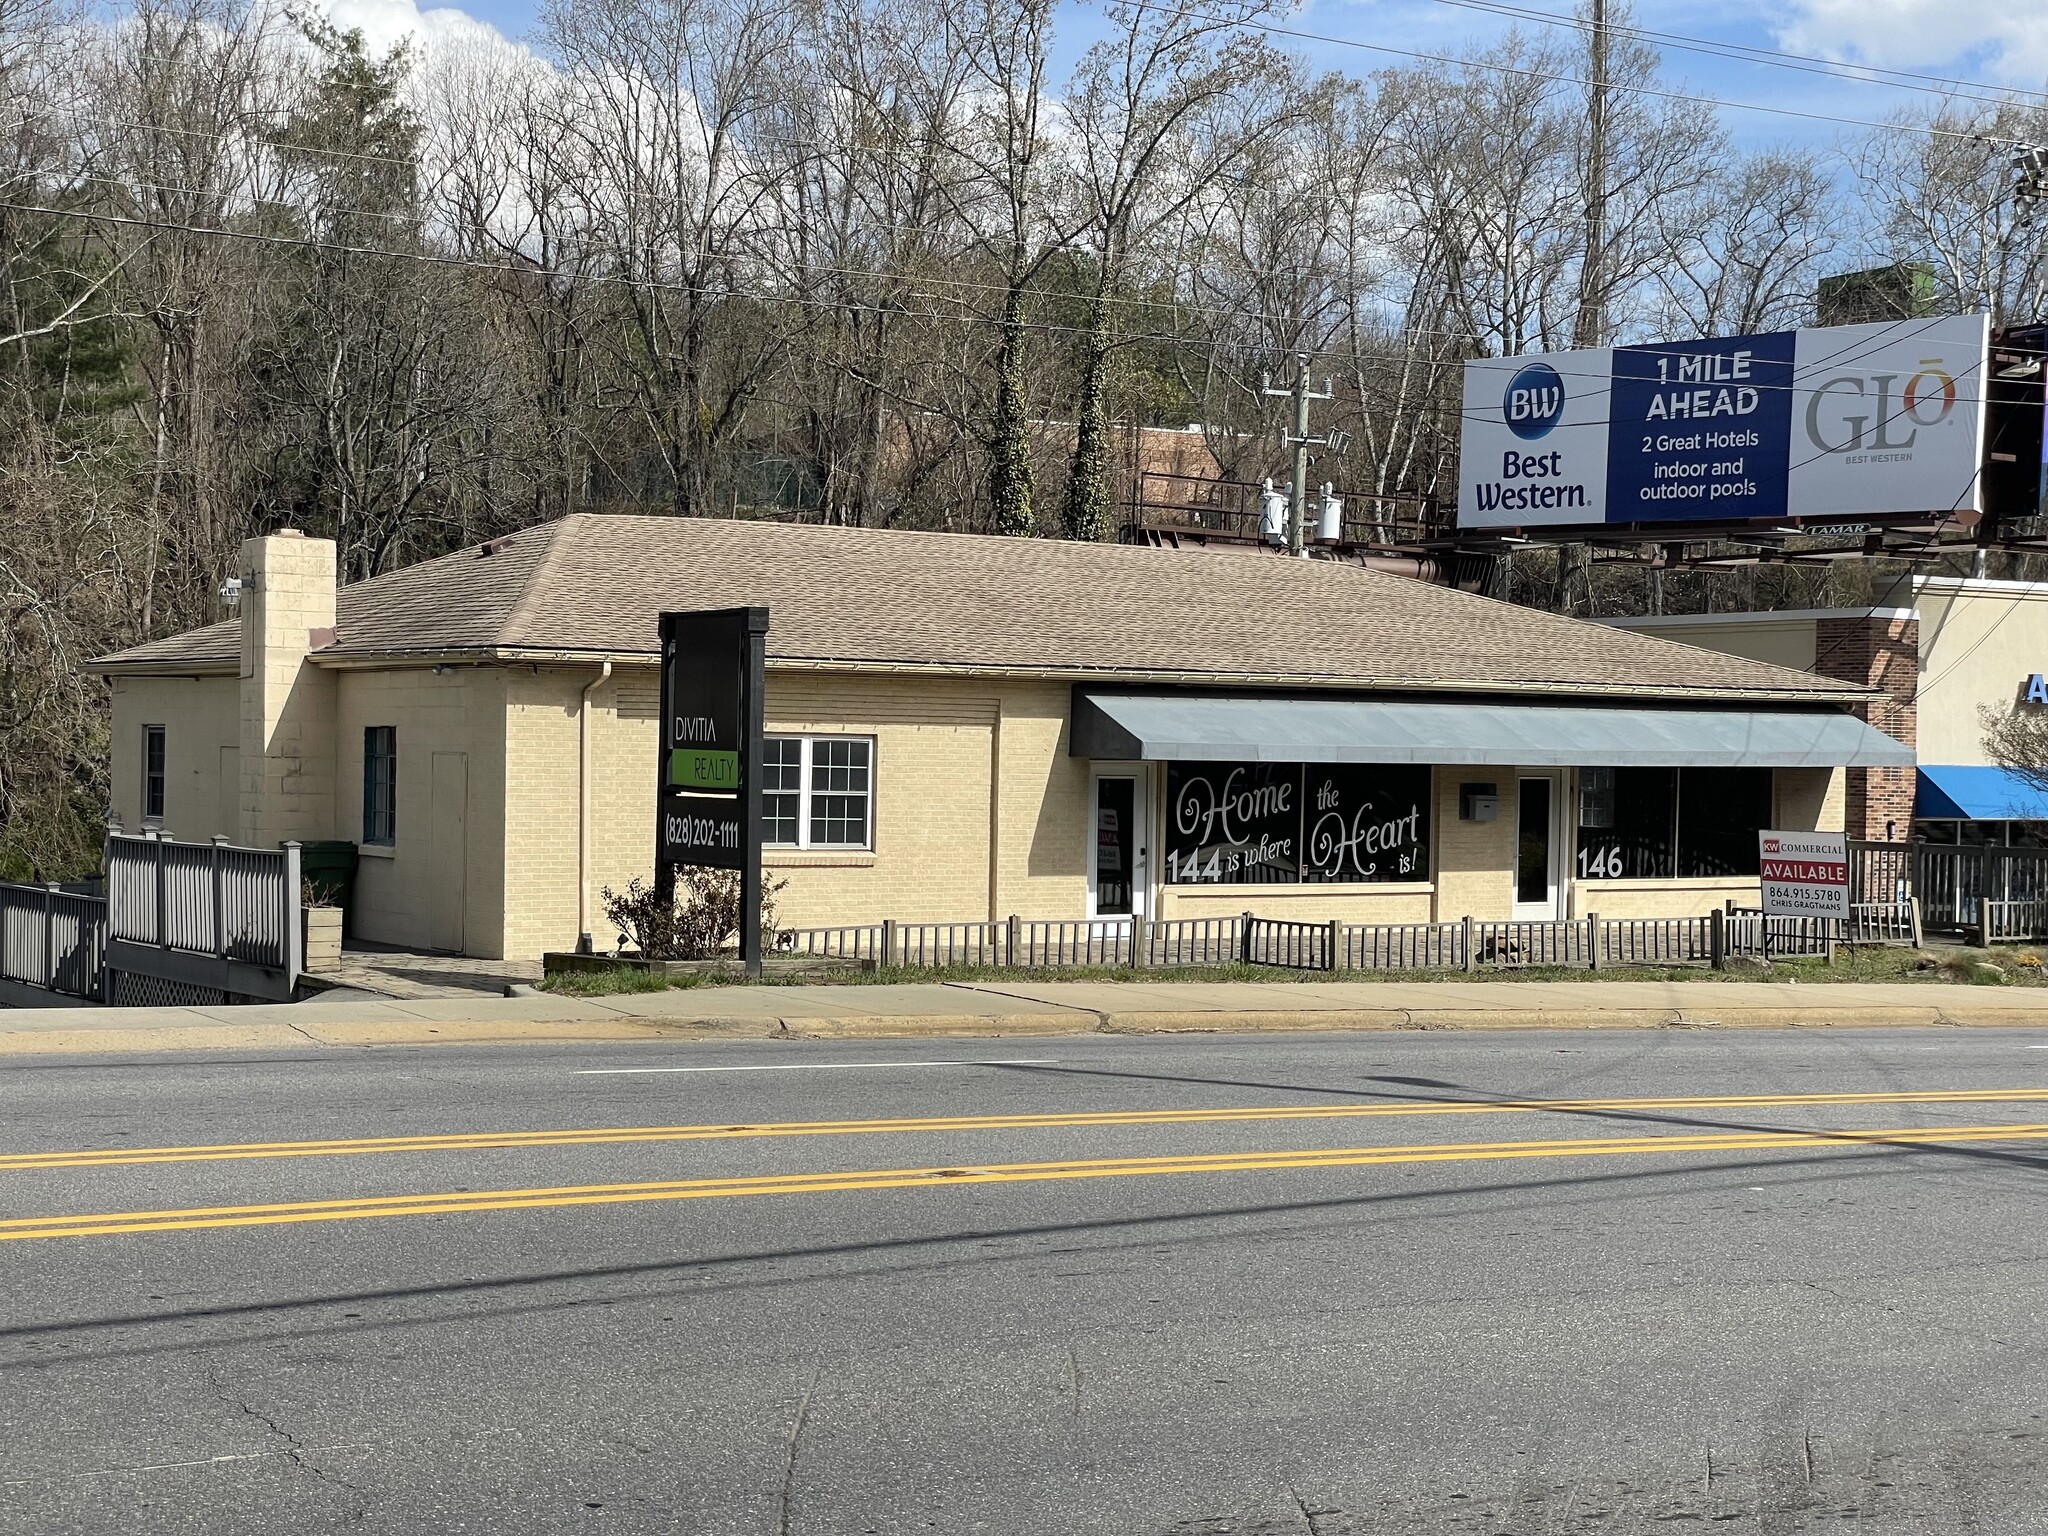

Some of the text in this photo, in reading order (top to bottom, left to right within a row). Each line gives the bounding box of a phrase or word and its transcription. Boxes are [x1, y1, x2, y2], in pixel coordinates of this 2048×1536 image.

[1657, 350, 1752, 385] 1 MILE
[1510, 386, 1559, 421] BW
[1645, 387, 1759, 421] AHEAD
[1641, 429, 1759, 453] 2 Great Hotels
[1503, 451, 1562, 479] Best
[1654, 457, 1744, 479] indoor and
[1845, 453, 1913, 465] BEST WESTERN
[1640, 478, 1757, 500] outdoor pools
[1812, 525, 1866, 535] LAMAR
[675, 717, 717, 742] DIVITIA
[694, 757, 734, 781] REALTY
[1176, 767, 1292, 846] Home
[1316, 779, 1339, 810] the
[1310, 802, 1420, 877] Heart
[1764, 842, 1844, 855] KW COMMERCIAL
[1167, 847, 1222, 883] 144
[1227, 833, 1291, 872] is where
[1578, 846, 1623, 878] 146
[1763, 863, 1845, 881] AVAILABLE
[1769, 886, 1841, 902] 864.915.5780
[1770, 899, 1841, 911] CHRIS GRAGTMANS
